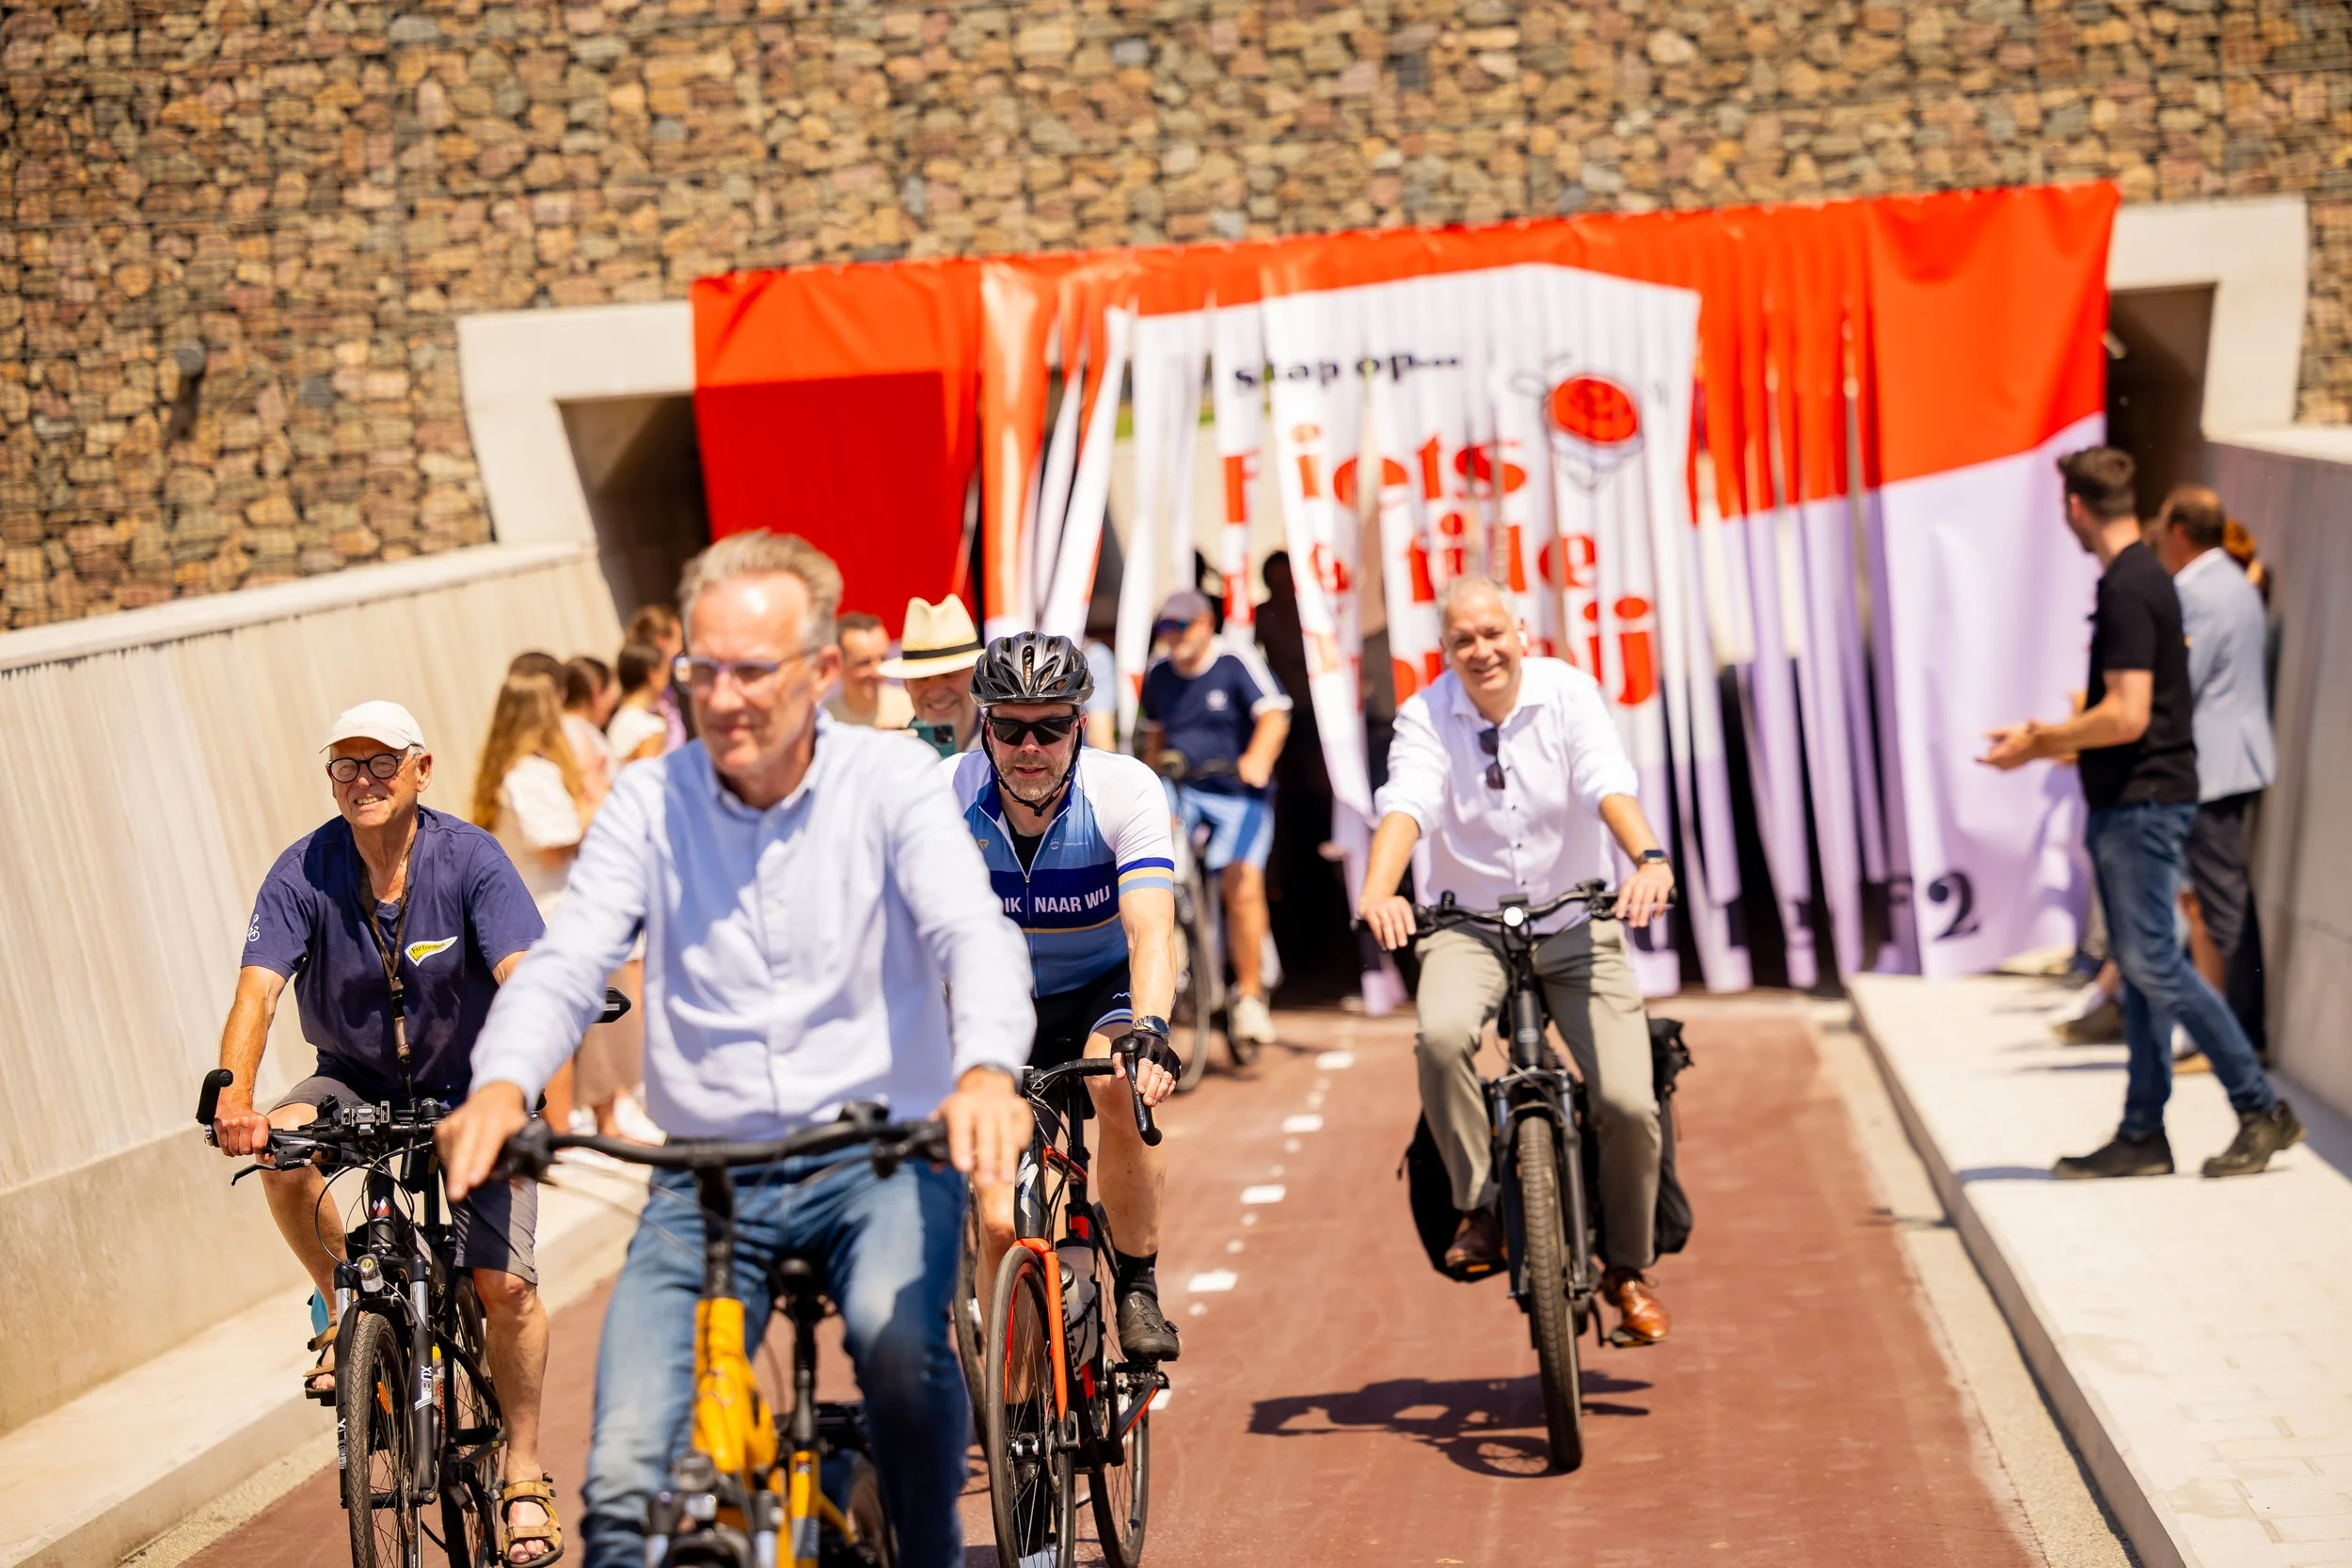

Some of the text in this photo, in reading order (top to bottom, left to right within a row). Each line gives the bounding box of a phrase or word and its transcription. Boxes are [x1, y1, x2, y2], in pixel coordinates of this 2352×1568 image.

[1235, 364, 1339, 387] sap
[1035, 896, 1083, 913] NAAR
[1085, 884, 1111, 910] WIJ
